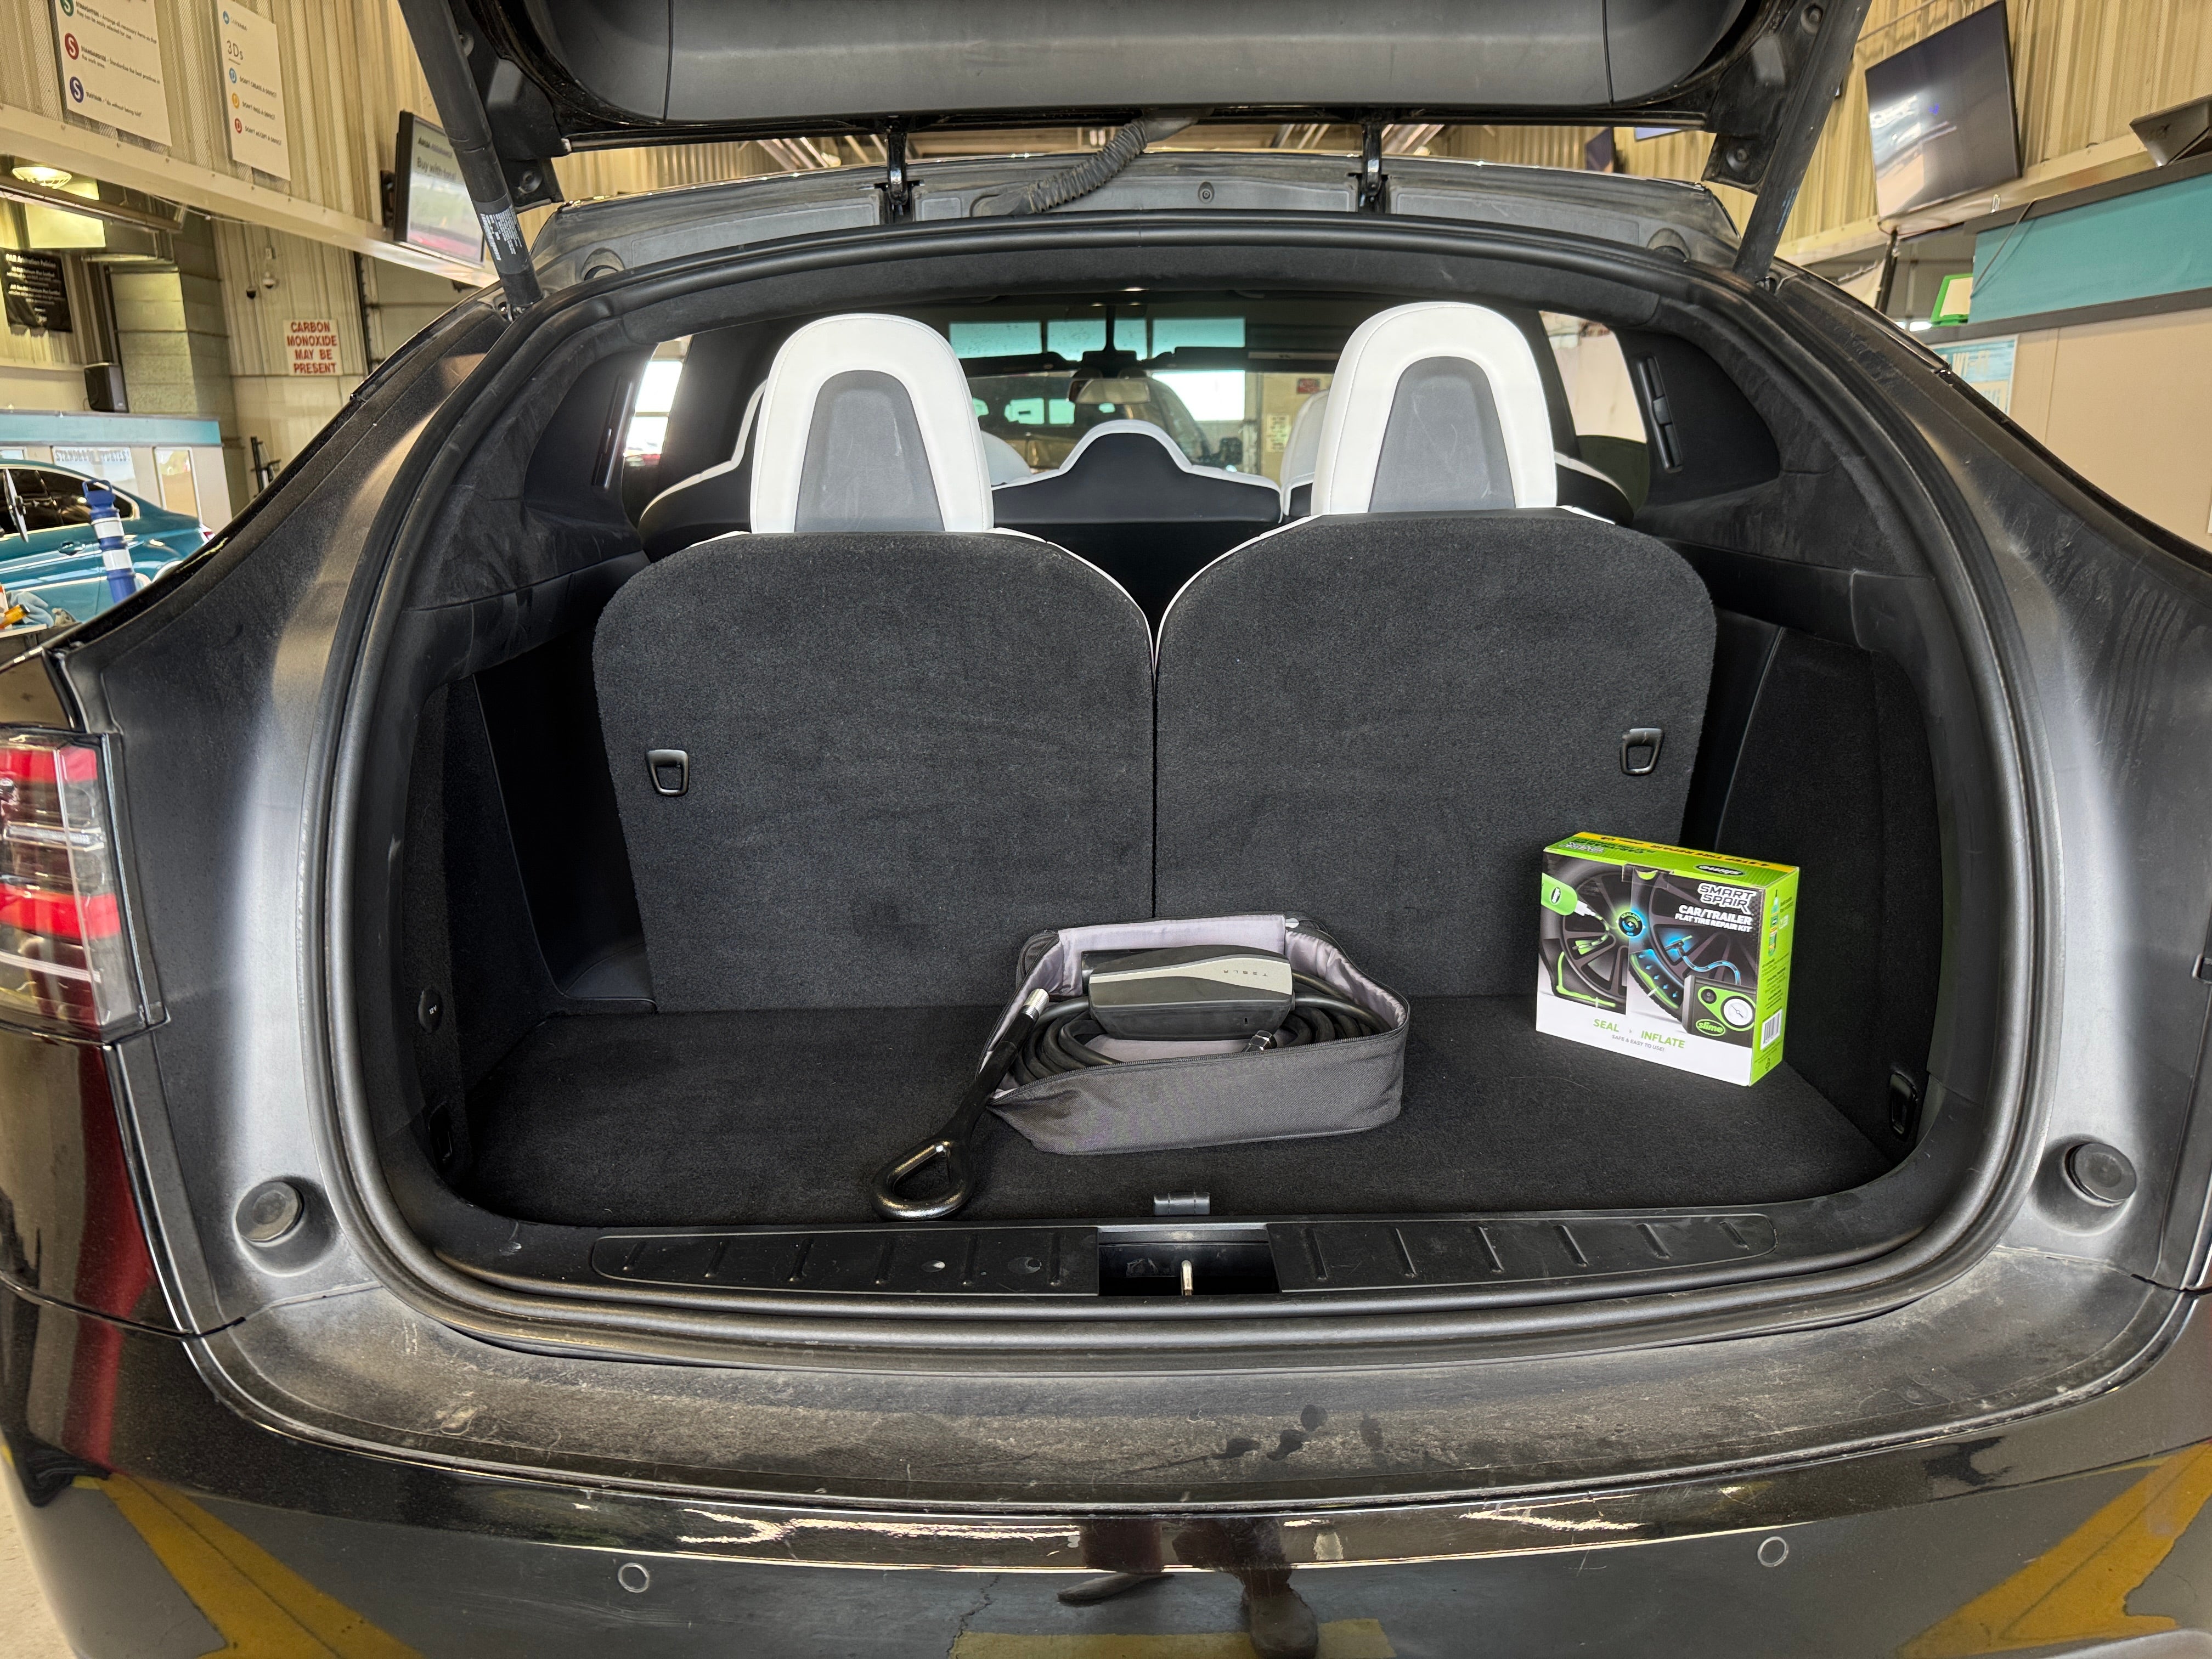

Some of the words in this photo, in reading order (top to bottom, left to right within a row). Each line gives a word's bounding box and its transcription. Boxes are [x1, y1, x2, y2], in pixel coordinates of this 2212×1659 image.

[227, 40, 244, 60] 3Ds
[291, 321, 331, 333] CARBON
[287, 335, 337, 347] MONOXIDE
[295, 349, 314, 360] MAY
[319, 349, 332, 360] BE
[294, 363, 336, 374] PRESENT
[1650, 845, 1695, 855] REPAIR
[1696, 851, 1723, 860] TIRE
[1724, 857, 1769, 867] 4-STEP
[1699, 865, 1742, 876] slime
[1699, 884, 1755, 900] SMART
[1701, 893, 1752, 915] SPAIR
[1621, 912, 1640, 922] SEALANT
[1679, 905, 1753, 926] CAR/TRAILER
[1675, 913, 1694, 922] FLAT
[1694, 917, 1711, 926] TIRE
[1710, 919, 1738, 931] REPAIR
[429, 1005, 437, 1014] 12V
[1698, 1022, 1723, 1033] slime
[1593, 1019, 1619, 1032] SEAL
[1641, 1030, 1686, 1049] INFLATE
